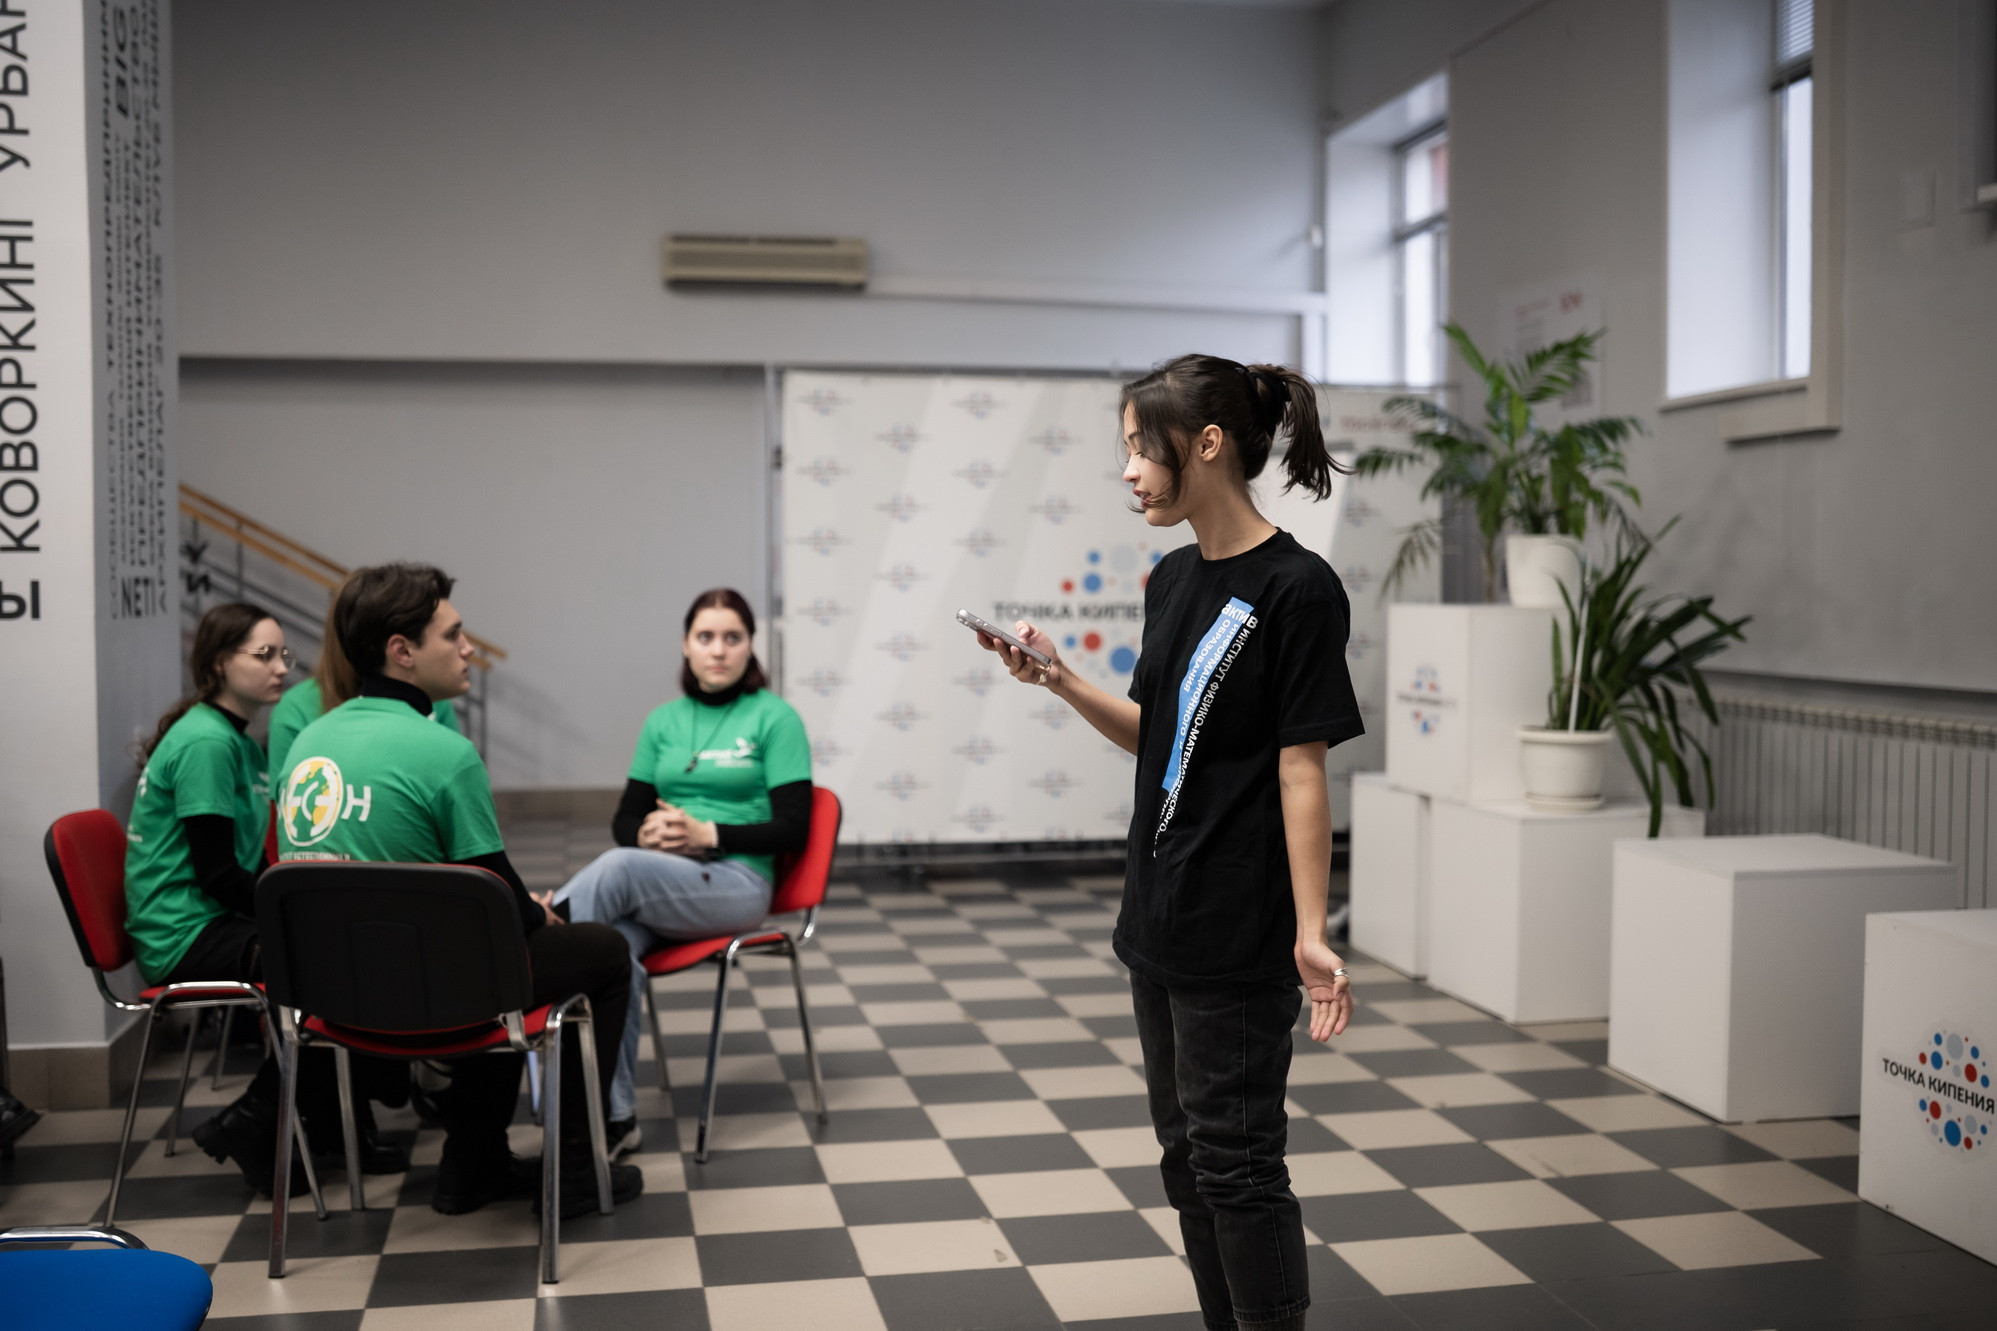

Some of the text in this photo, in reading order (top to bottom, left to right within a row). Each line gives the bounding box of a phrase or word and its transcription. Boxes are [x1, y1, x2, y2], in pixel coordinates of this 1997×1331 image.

[1079, 602, 1144, 621] КИПЕ
[1180, 623, 1239, 736] ИНФОРМАЦИОННОГО
[1183, 619, 1231, 692] ОБРАЗОВАНИЯ
[1215, 628, 1251, 682] ИНСТИТУТ
[1882, 1057, 1995, 1114] ТОЧКА КИПЕНИЯ
